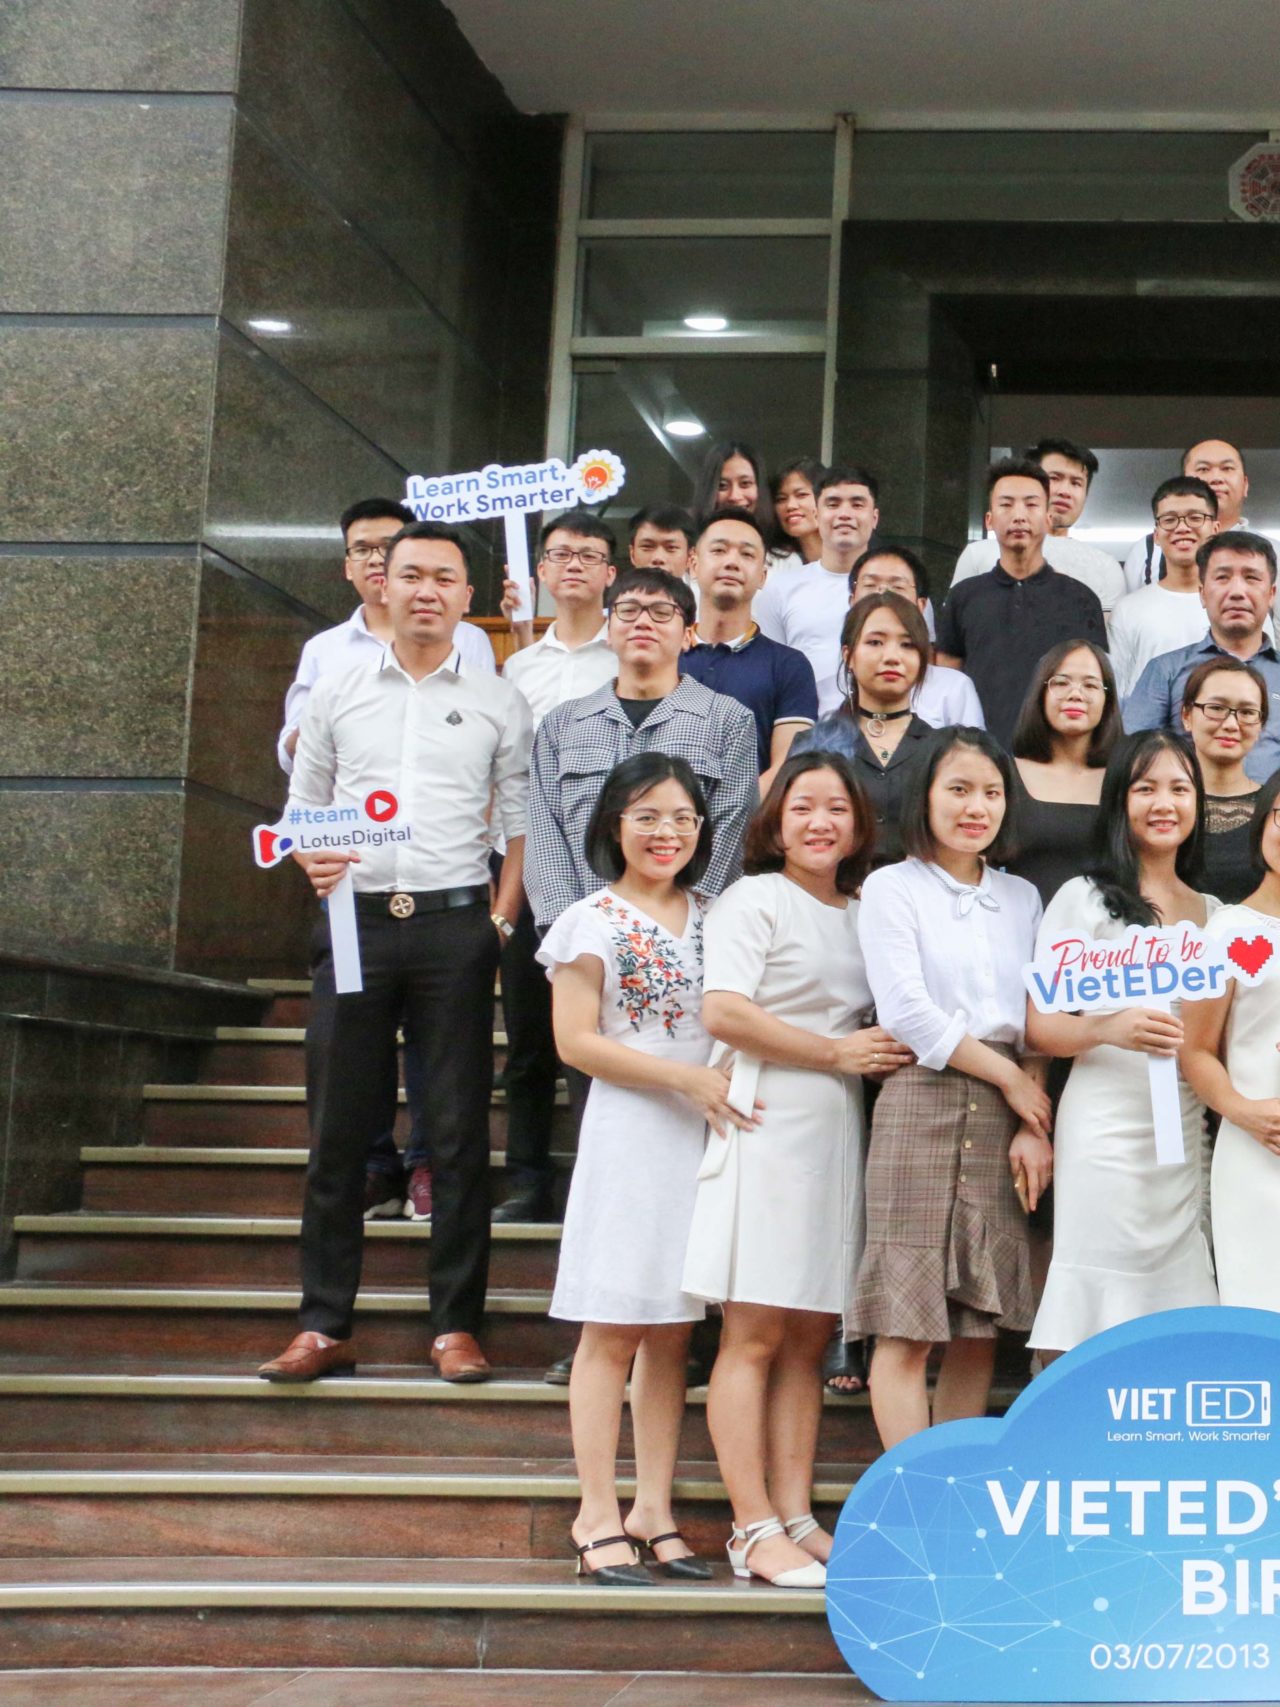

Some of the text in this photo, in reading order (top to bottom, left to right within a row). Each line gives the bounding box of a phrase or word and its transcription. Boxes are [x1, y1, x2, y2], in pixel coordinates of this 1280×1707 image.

[412, 463, 567, 500] Learn Smart,
[412, 487, 575, 521] Work Smarter
[288, 808, 359, 825] #team
[300, 826, 411, 849] LotusDigital
[1051, 931, 1208, 985] Proud to be
[1032, 962, 1225, 1005] VietEDer
[1107, 1387, 1255, 1421] VIET ED
[1107, 1430, 1271, 1443] Learn Smart, Work Smarter
[1089, 1642, 1271, 1671] 03/07/2013
